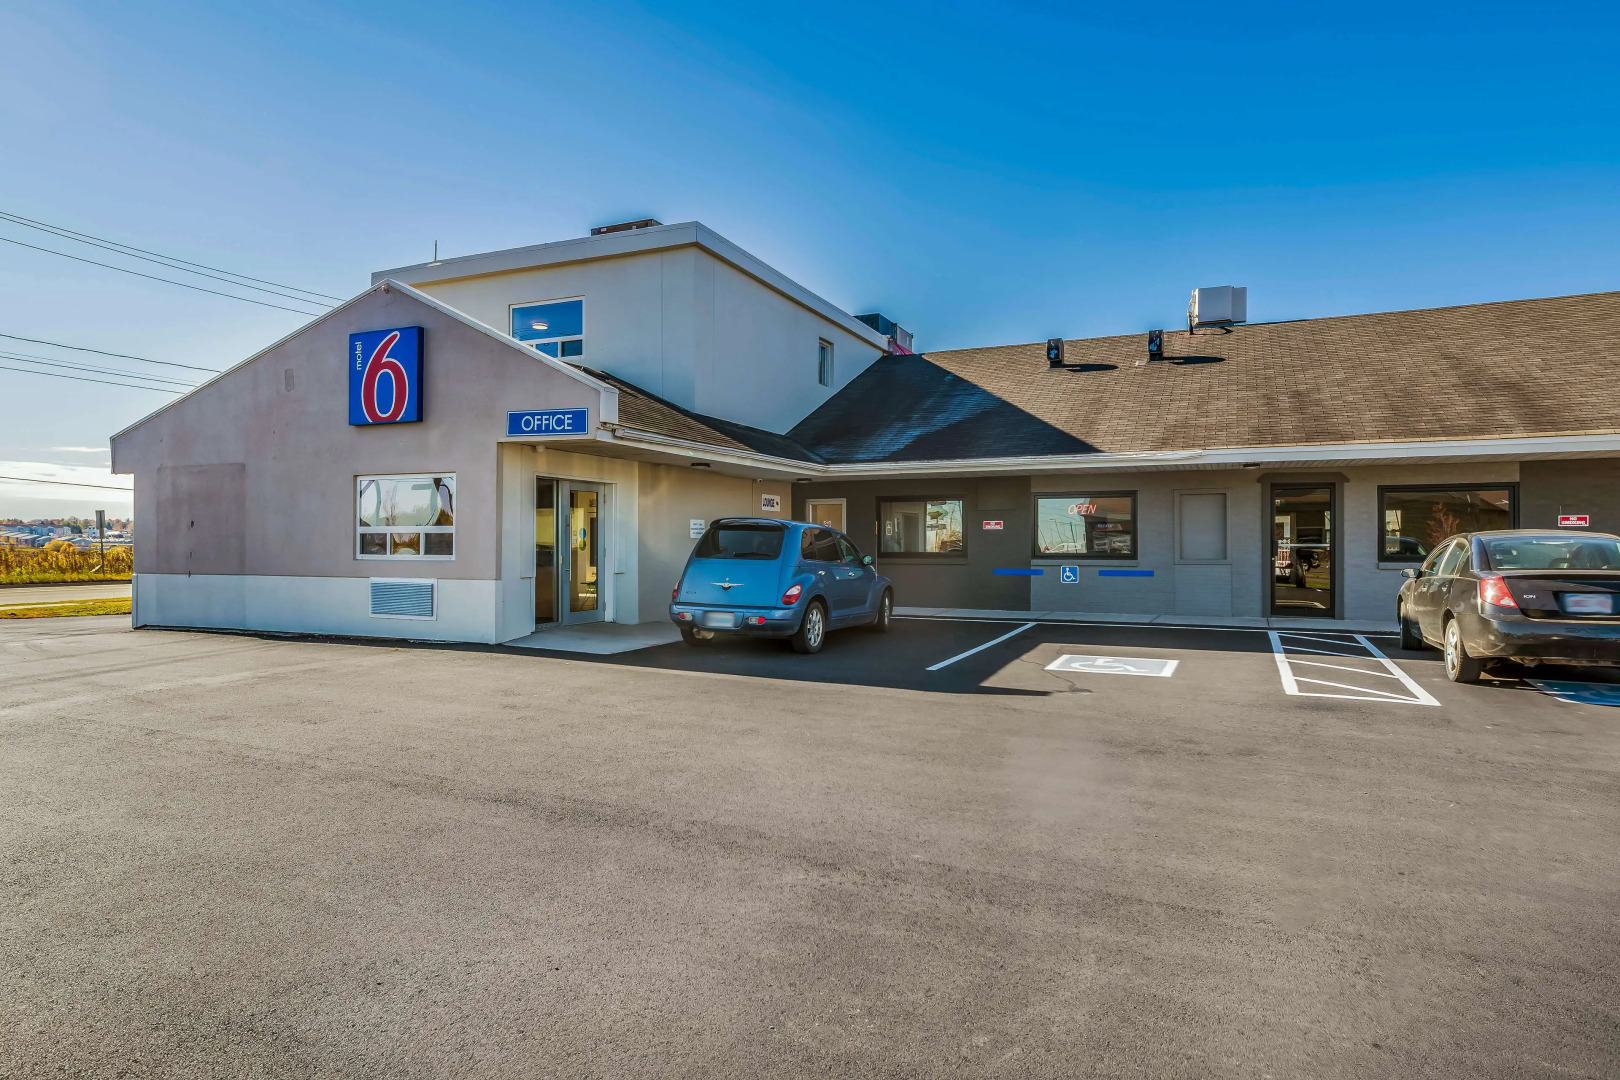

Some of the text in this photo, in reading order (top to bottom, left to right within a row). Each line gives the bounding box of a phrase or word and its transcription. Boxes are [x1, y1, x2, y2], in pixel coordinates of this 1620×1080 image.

[361, 330, 409, 423] 6
[521, 414, 573, 431] OFFICE
[1068, 504, 1097, 515] OPEN
